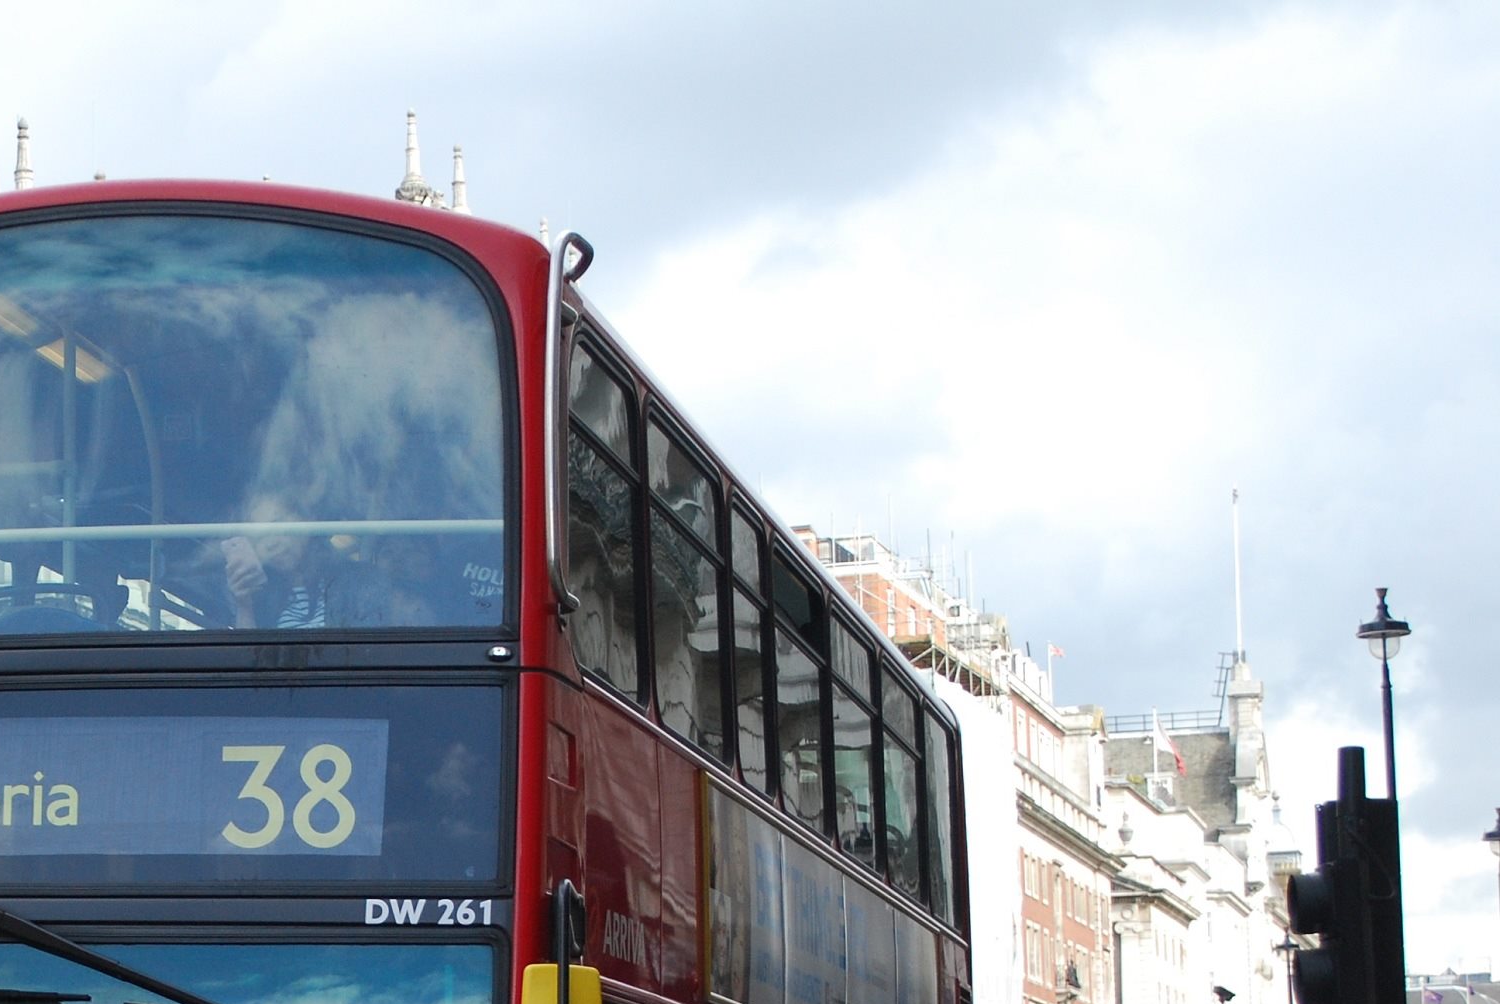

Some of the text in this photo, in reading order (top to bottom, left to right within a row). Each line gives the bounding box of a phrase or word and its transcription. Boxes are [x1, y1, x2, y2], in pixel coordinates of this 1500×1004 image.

[220, 743, 357, 849] 38
[364, 898, 492, 926] DW 261
[603, 908, 647, 968] ARRIVA
